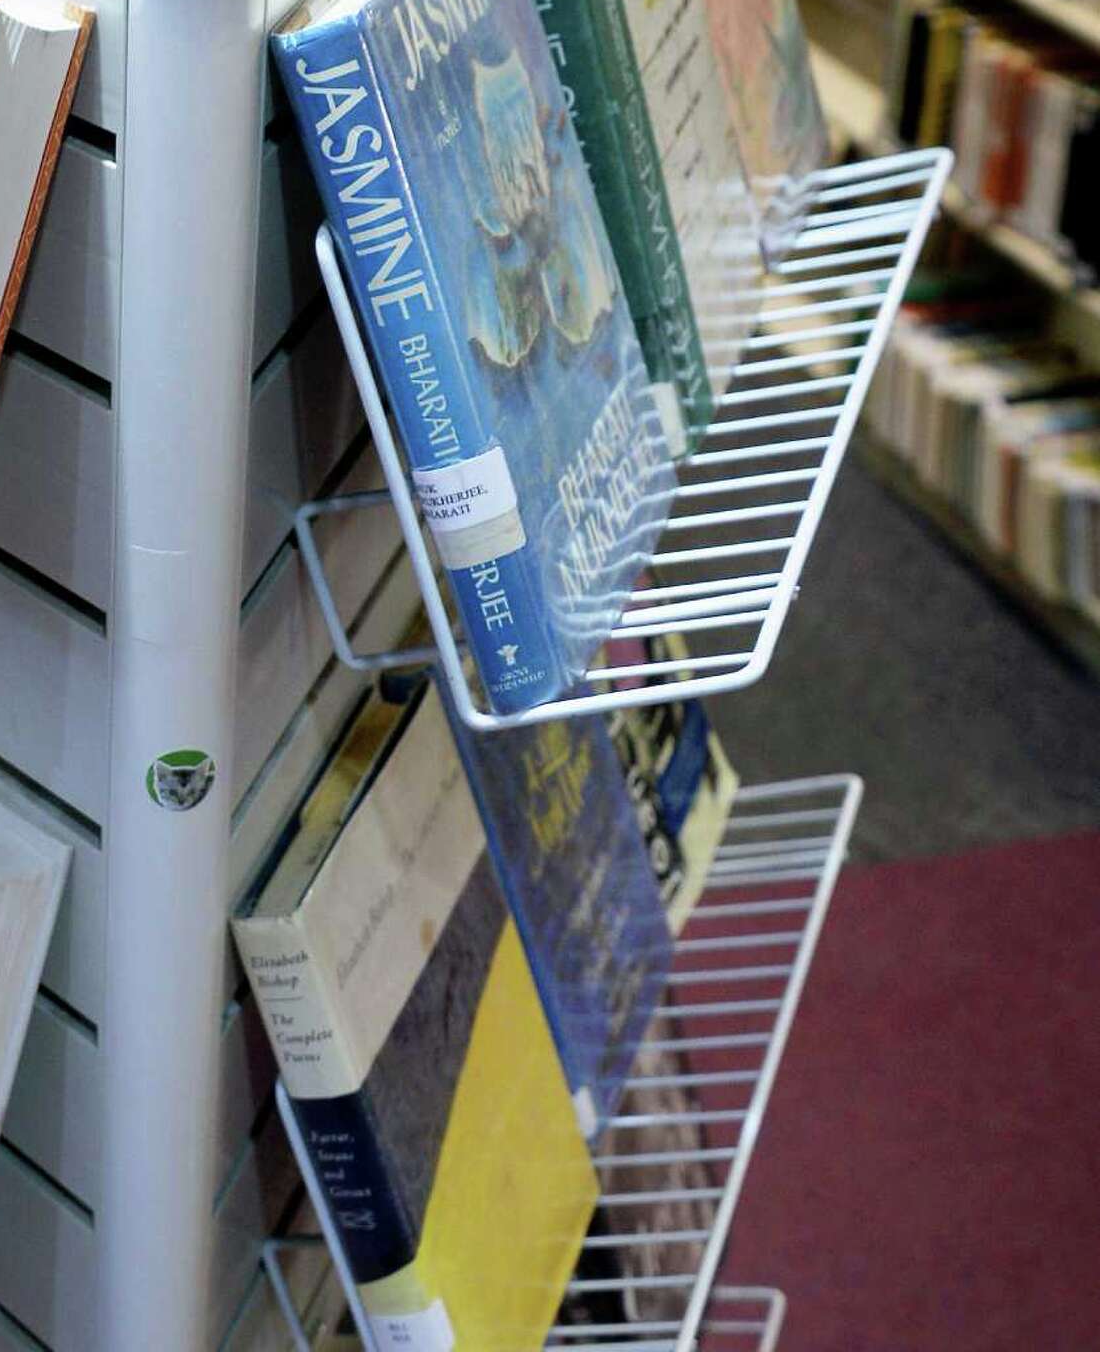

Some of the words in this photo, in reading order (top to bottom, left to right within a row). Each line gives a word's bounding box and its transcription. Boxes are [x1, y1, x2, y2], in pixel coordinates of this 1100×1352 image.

[295, 56, 435, 328] JASMINE
[398, 332, 462, 460] BHARATI
[623, 85, 679, 302] SHAKERS
